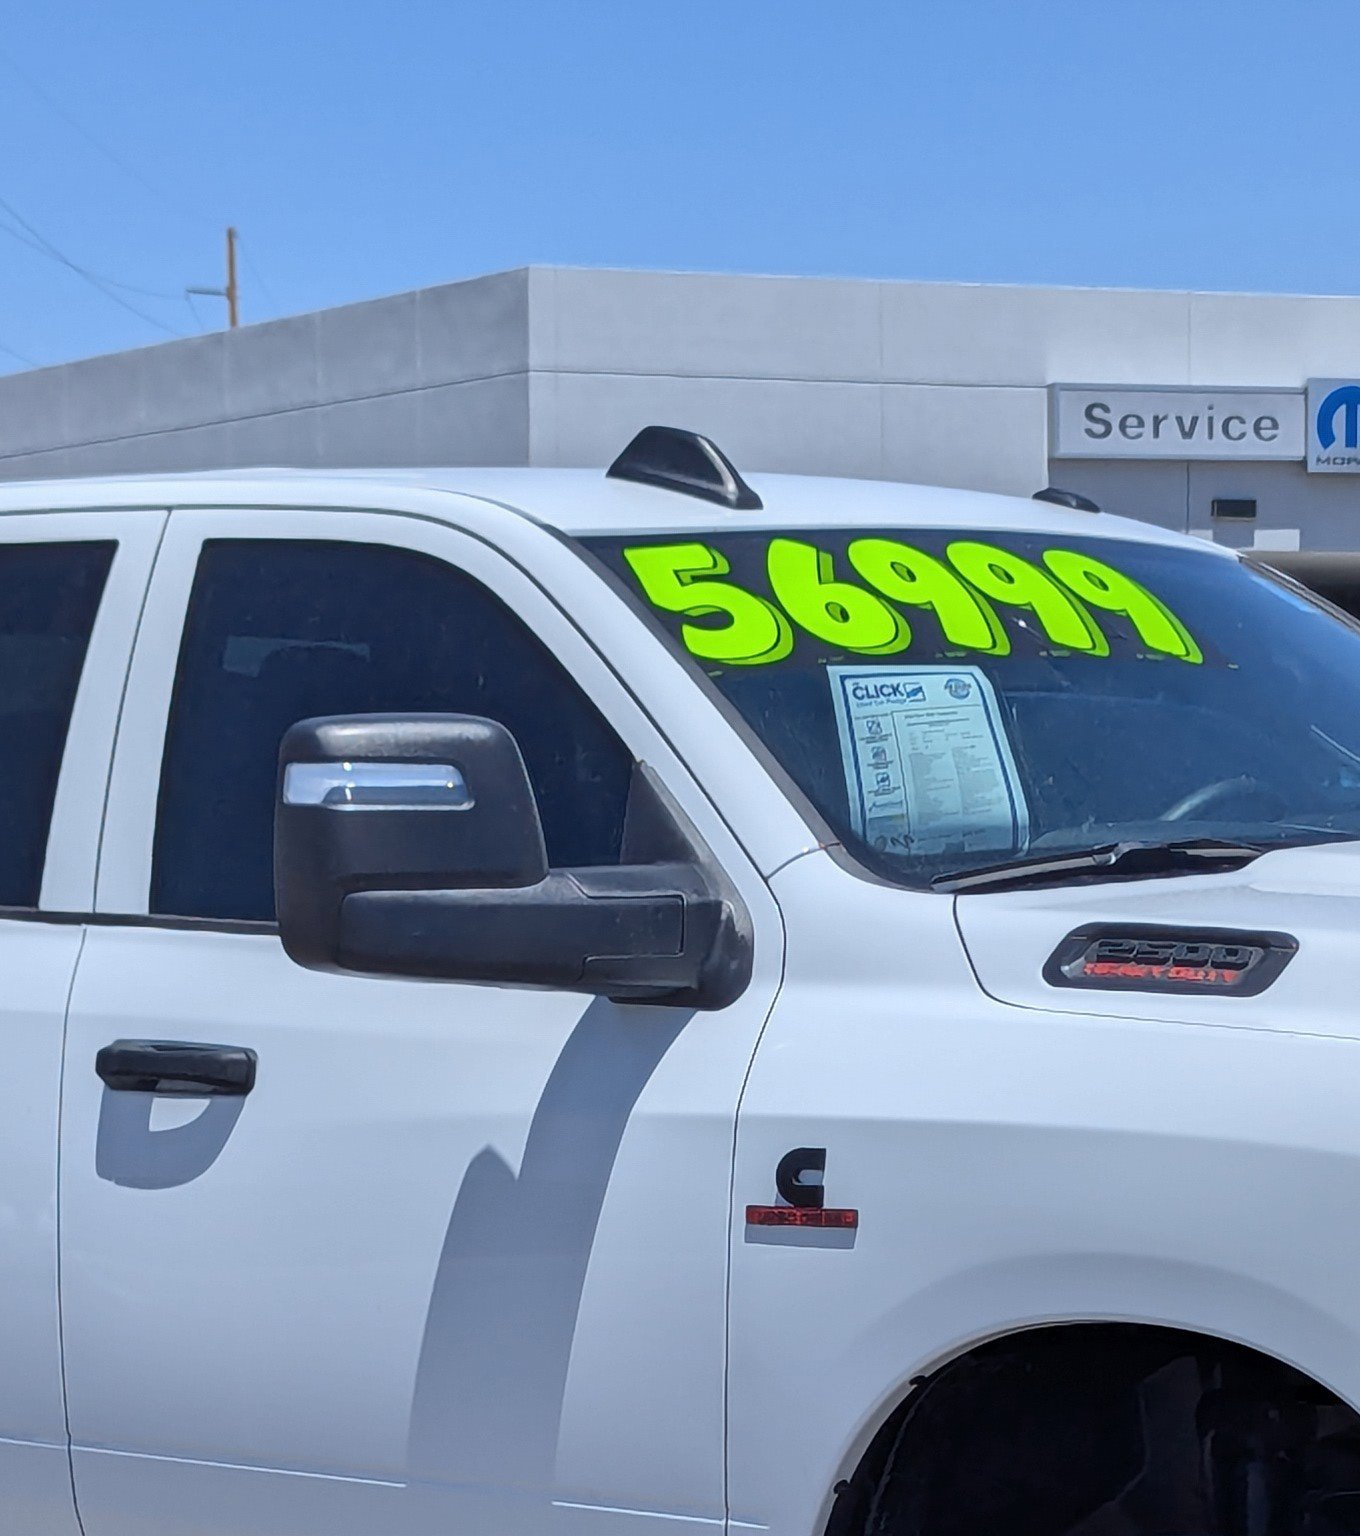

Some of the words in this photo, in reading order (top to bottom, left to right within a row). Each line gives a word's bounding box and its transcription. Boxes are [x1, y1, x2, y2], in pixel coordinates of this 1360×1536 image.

[1082, 402, 1281, 441] Service
[622, 537, 1204, 666] 56999
[852, 683, 905, 700] CLICK
[1096, 940, 1252, 970] 2500
